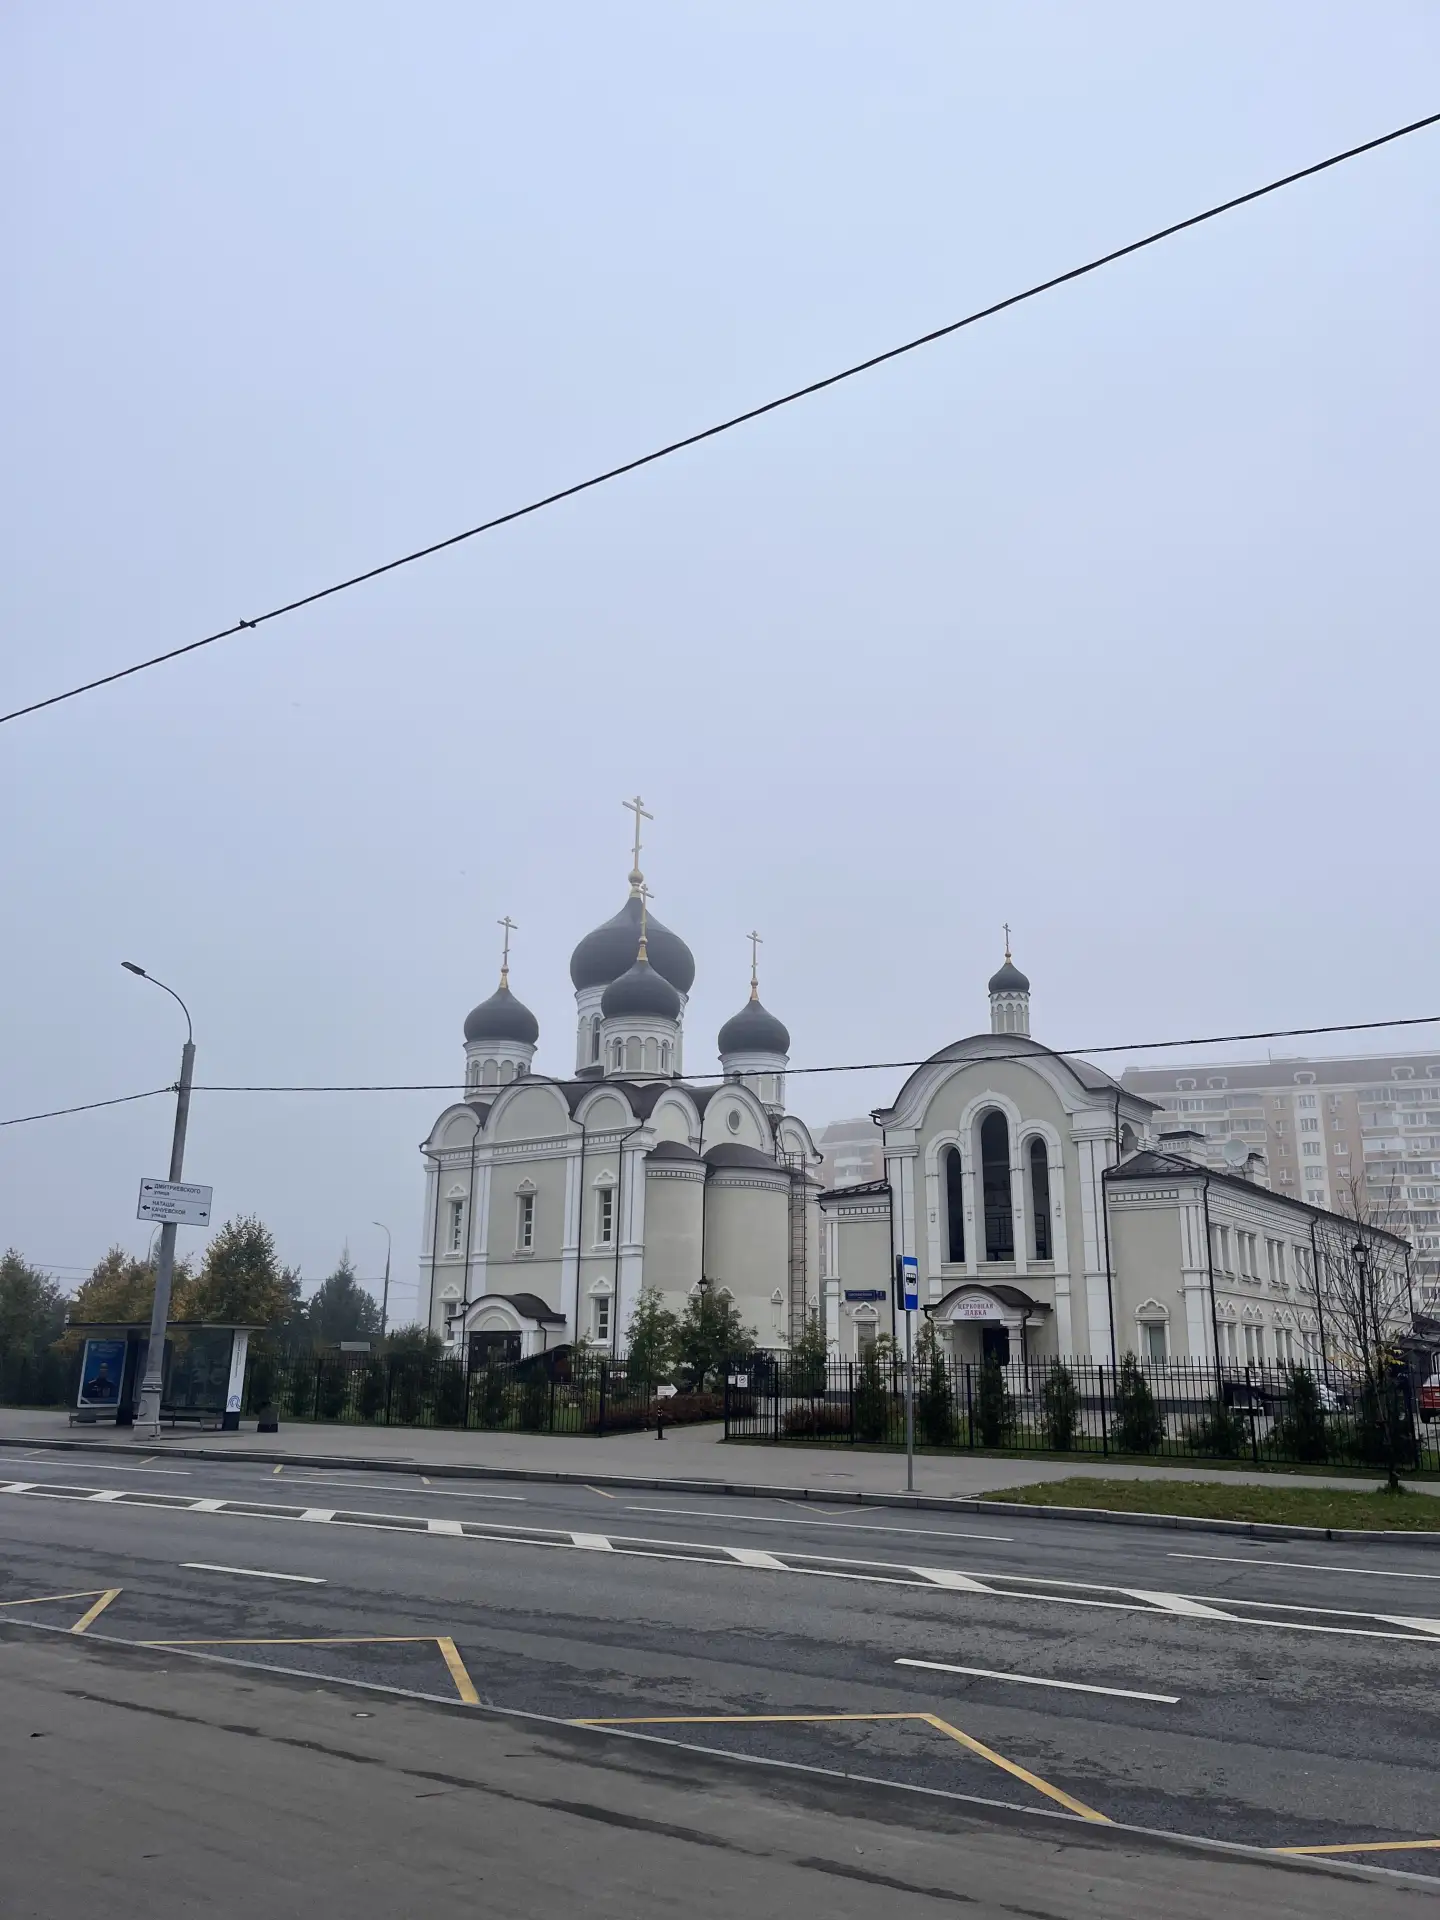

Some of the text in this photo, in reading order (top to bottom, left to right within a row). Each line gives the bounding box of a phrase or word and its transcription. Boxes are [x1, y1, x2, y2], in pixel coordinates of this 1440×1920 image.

[154, 1183, 201, 1194] ДМИТРИЕВСКОГО
[152, 1200, 175, 1208] НАТАШИ
[957, 1303, 994, 1311] ЦЕРКОВНАЯ
